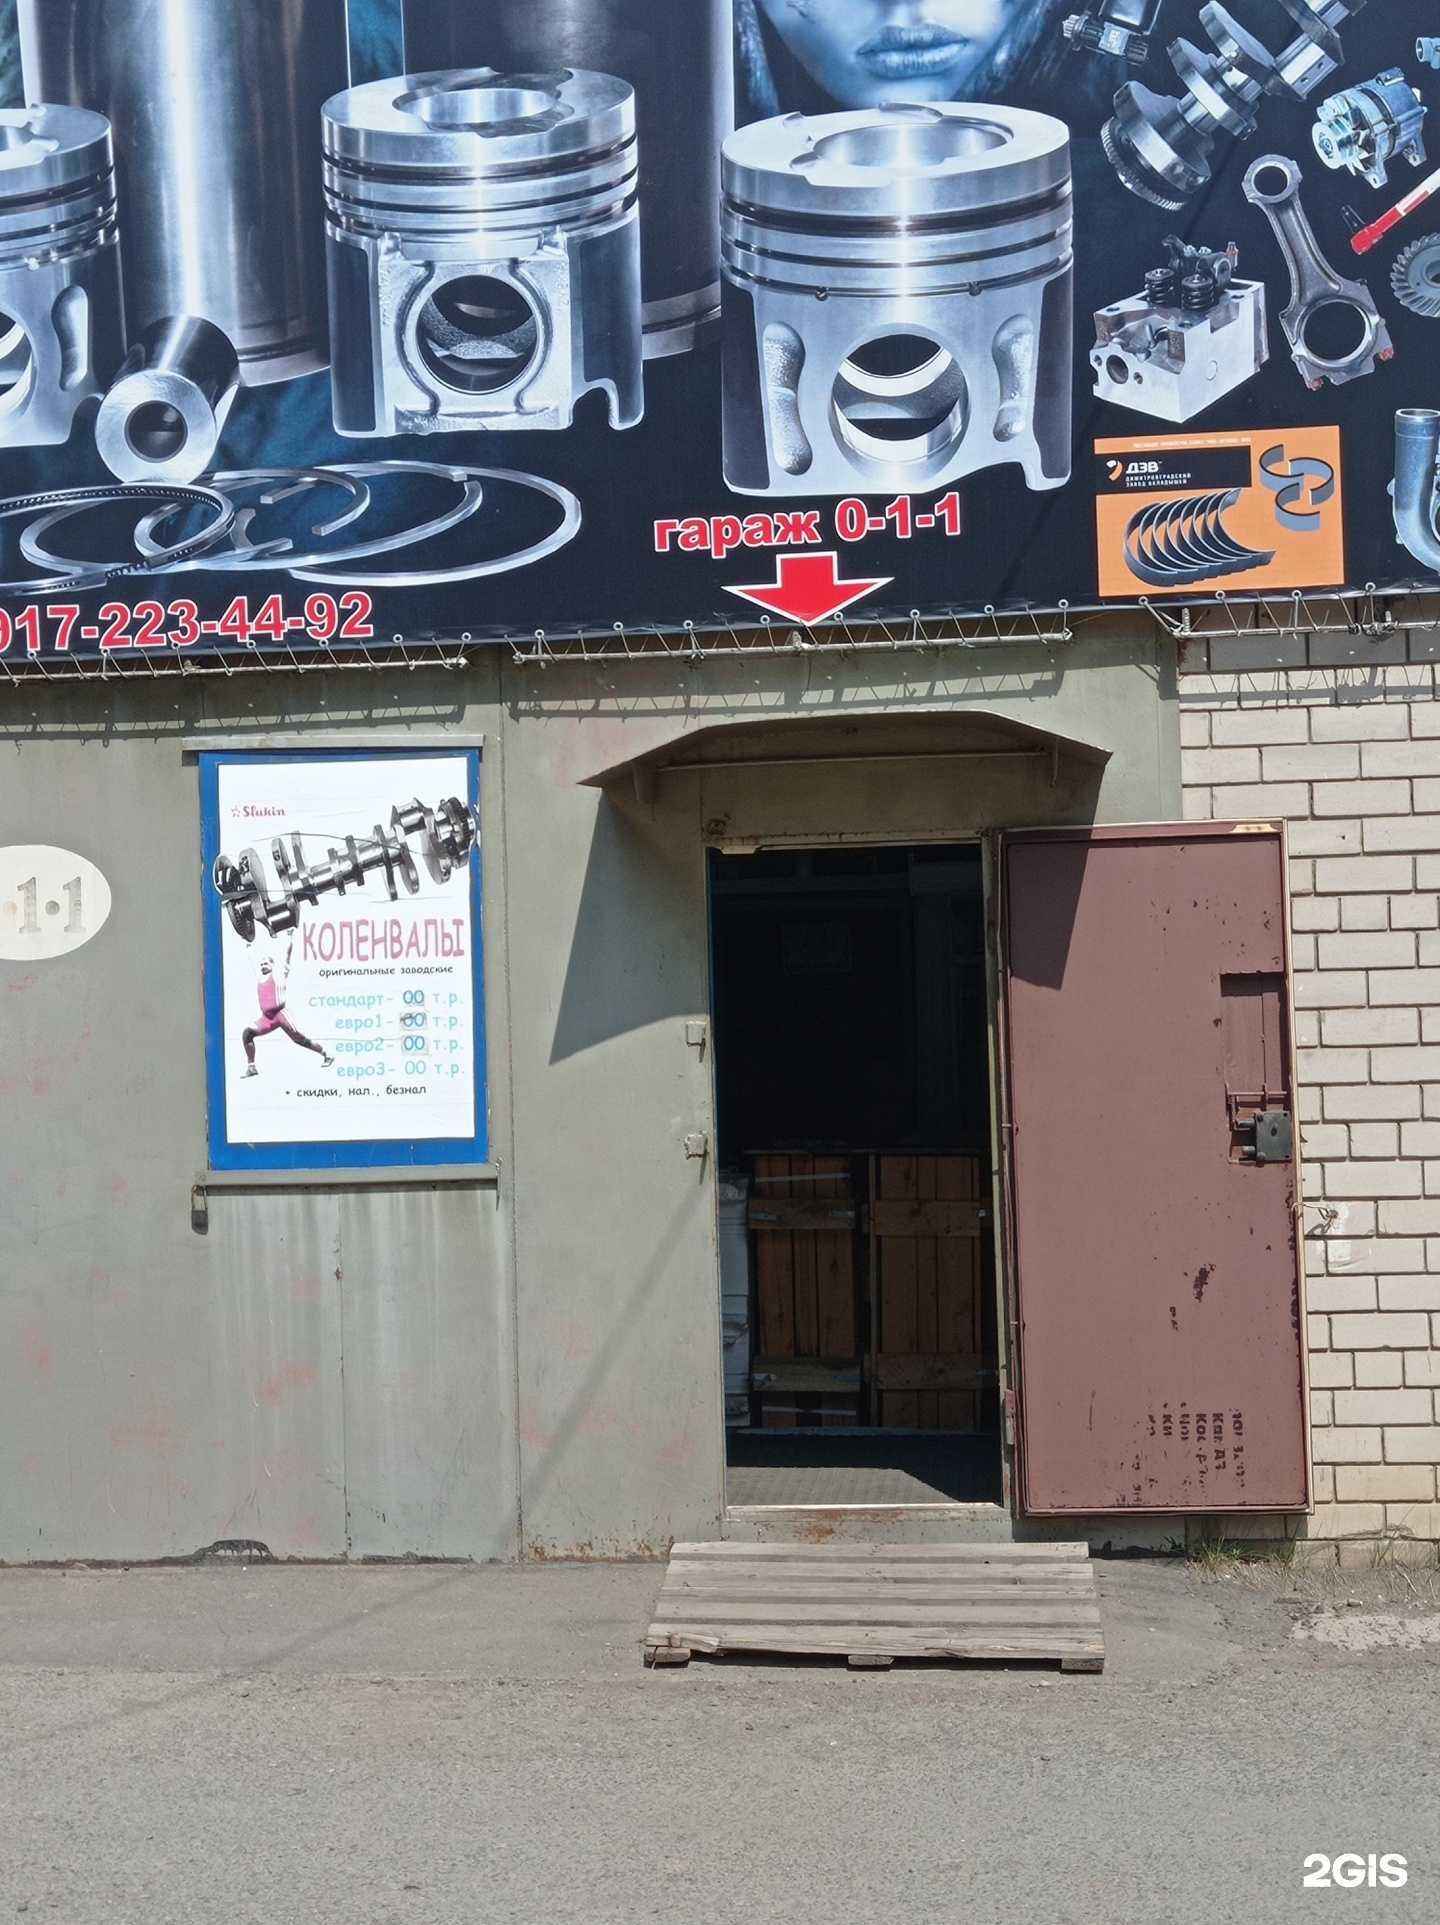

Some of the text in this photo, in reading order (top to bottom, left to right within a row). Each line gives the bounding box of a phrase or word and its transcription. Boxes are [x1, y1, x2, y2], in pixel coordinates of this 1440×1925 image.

[653, 492, 961, 559] гараж 0-1-1
[303, 918, 465, 962] КОЛЕНВАЛЫ
[319, 966, 454, 979] оригинальные заводские
[385, 1084, 427, 1095] безнал
